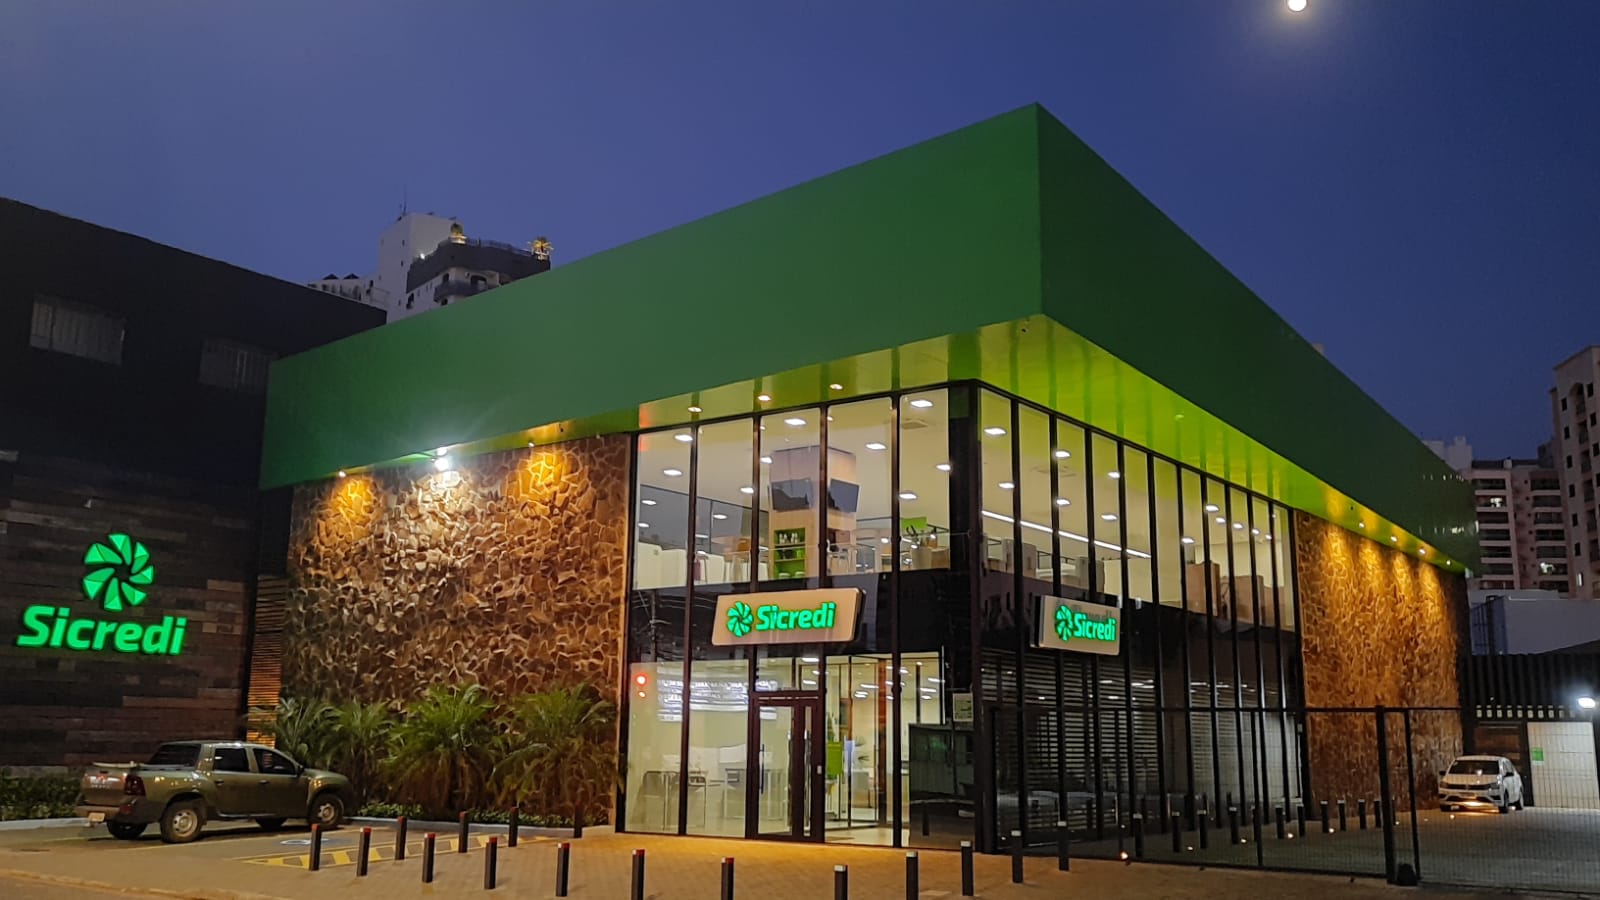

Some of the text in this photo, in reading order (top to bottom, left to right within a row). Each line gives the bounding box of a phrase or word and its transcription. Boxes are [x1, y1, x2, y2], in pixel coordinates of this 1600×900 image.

[18, 605, 187, 655] Sicredi
[756, 602, 836, 631] Sicredi
[1073, 613, 1117, 641] Sicredi
